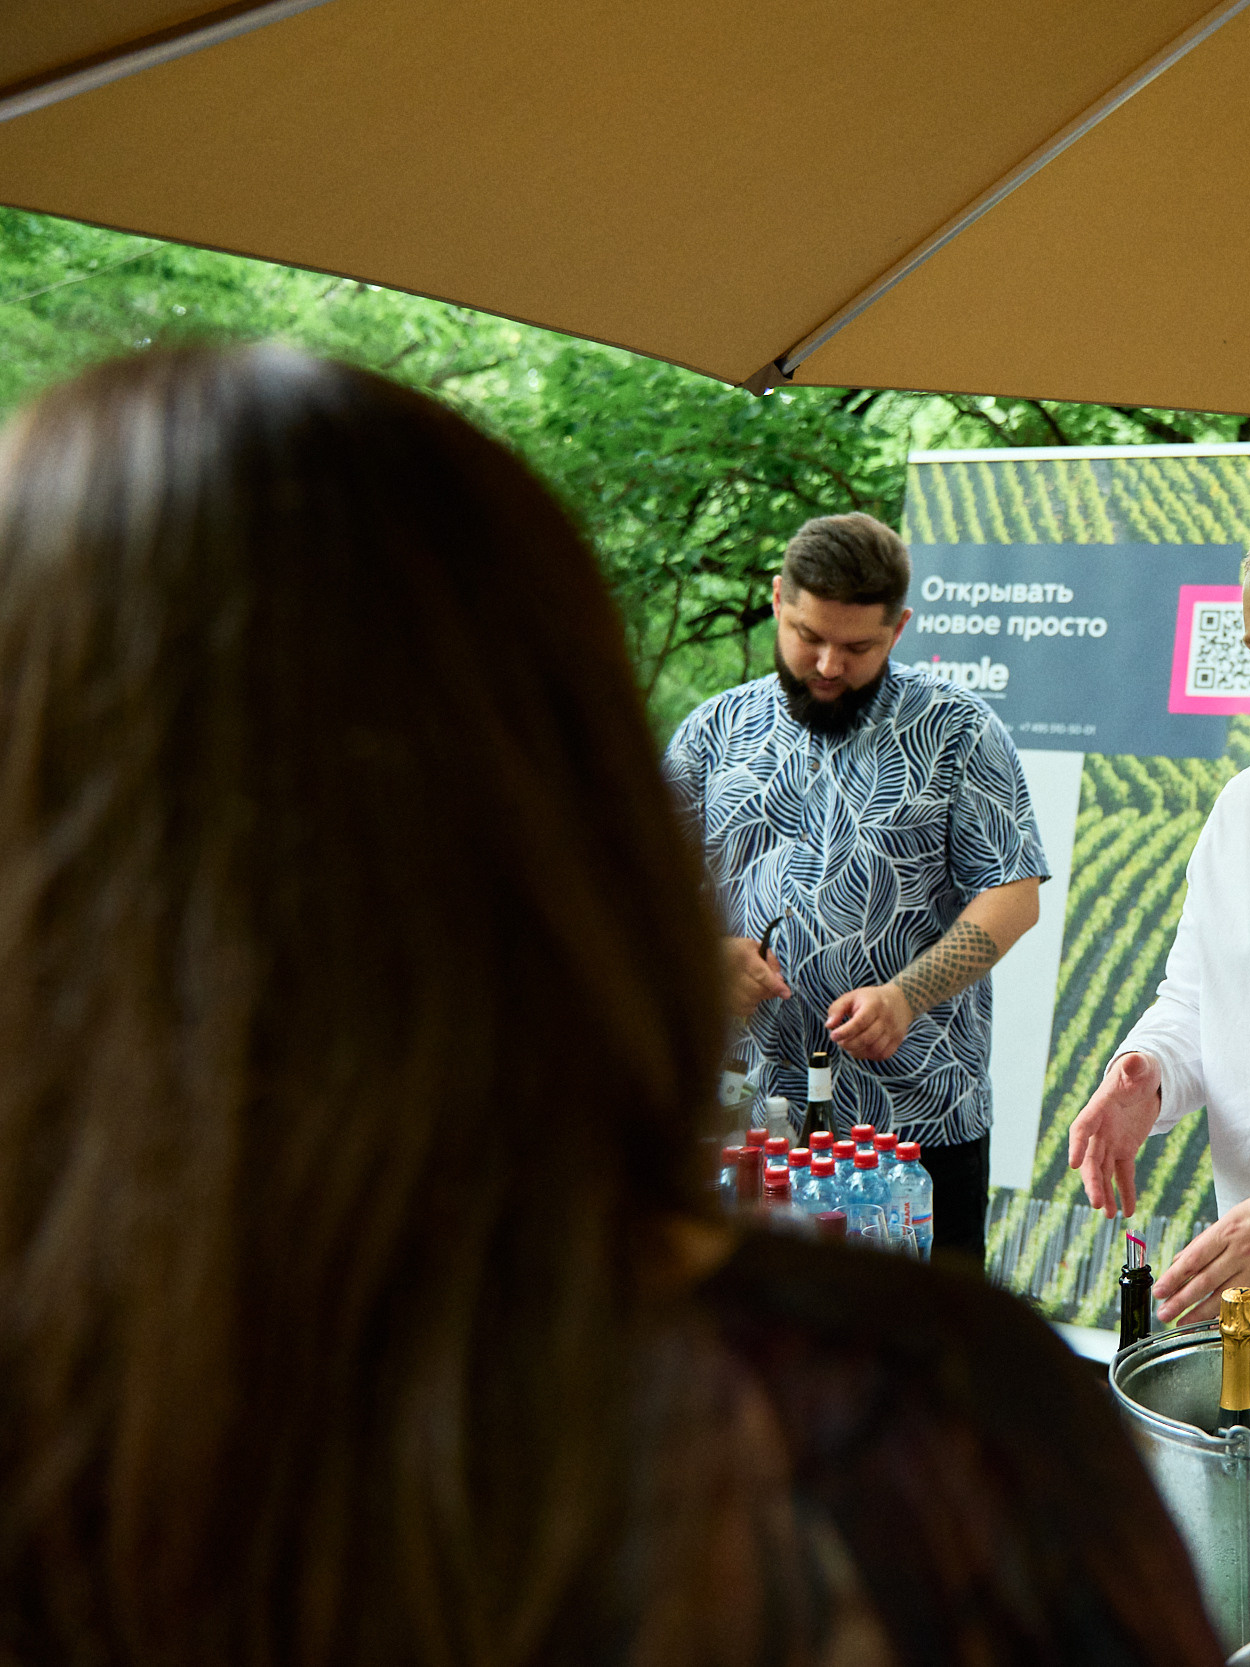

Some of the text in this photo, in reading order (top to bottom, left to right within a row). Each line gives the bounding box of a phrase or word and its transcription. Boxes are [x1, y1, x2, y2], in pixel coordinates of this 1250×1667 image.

[921, 575, 1074, 608] Открывать
[916, 613, 1109, 643] новое просто
